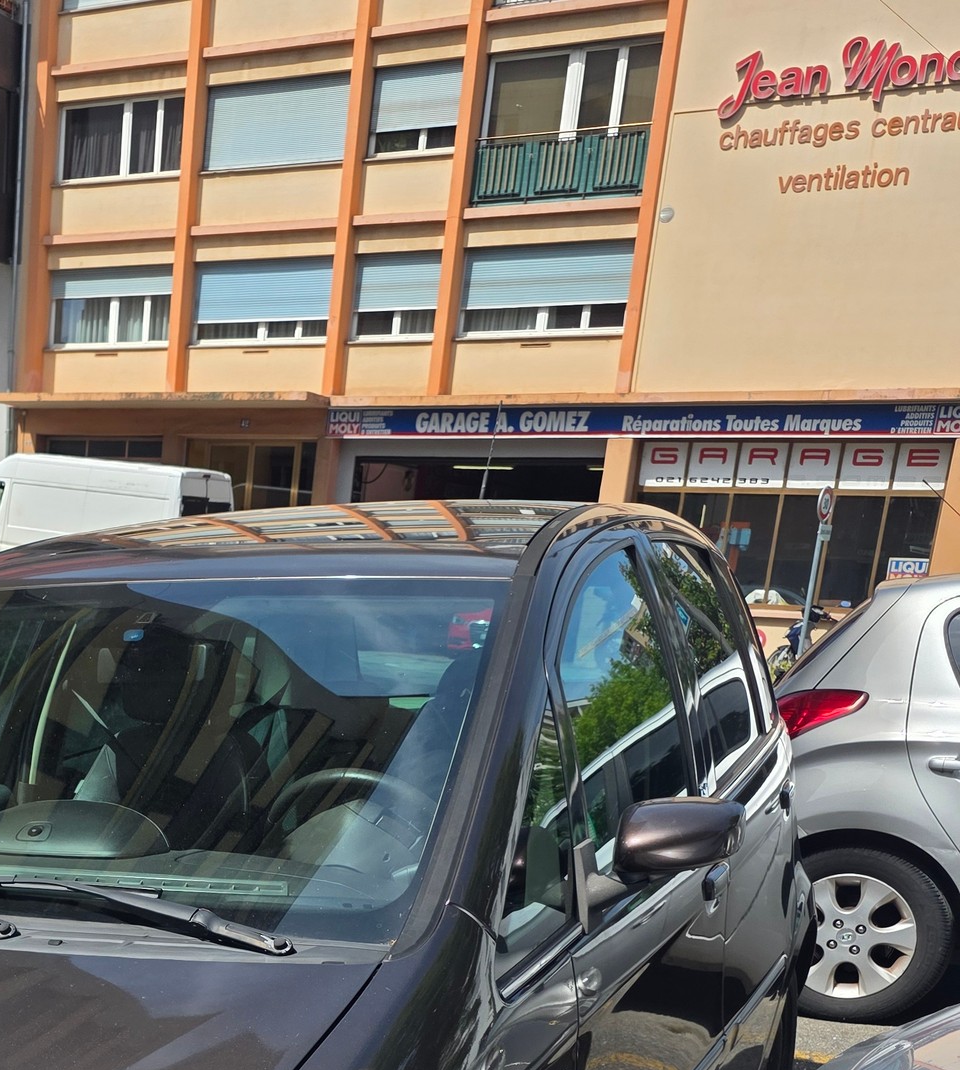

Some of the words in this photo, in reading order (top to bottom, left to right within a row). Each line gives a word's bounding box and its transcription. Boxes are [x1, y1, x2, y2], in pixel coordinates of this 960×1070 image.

[717, 50, 829, 119] Jean
[719, 119, 861, 151] chauffages
[871, 109, 960, 137] centra
[778, 162, 910, 194] ventilation
[329, 423, 360, 434] MOLY
[330, 411, 360, 423] LIQUI
[415, 412, 490, 433] GARAGE
[519, 410, 591, 432] GOMEZ
[621, 413, 721, 436] Réparations
[725, 414, 780, 432] Toutes
[783, 414, 862, 436] Marques
[900, 419, 933, 427] PRODUITS
[651, 447, 941, 467] GARAGE
